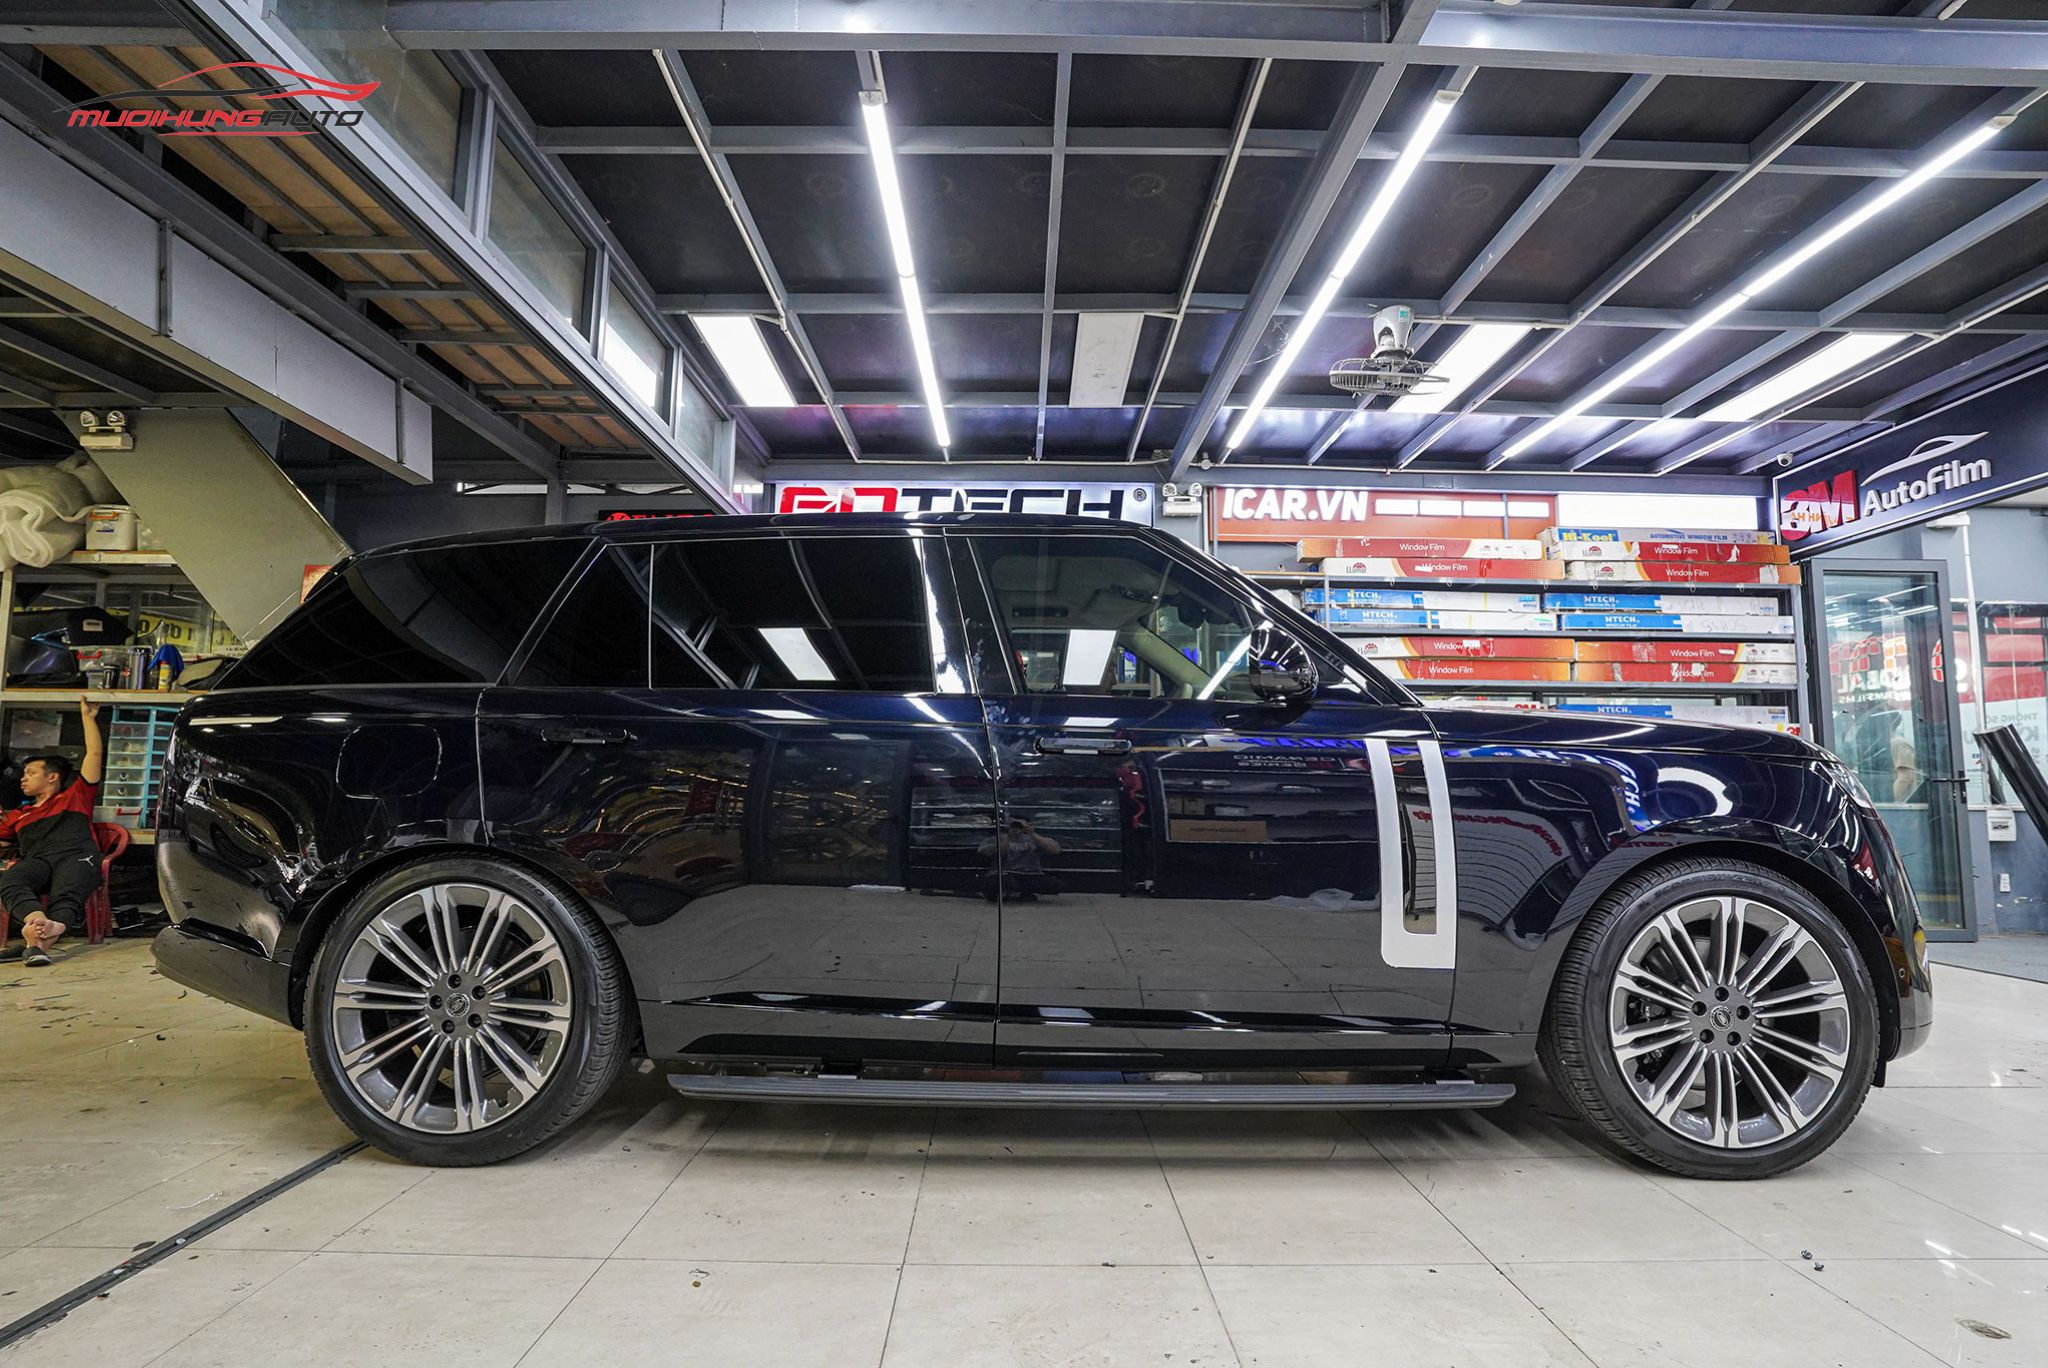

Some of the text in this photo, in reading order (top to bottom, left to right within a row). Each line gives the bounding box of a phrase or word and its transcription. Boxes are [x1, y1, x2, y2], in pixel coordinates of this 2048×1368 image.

[1781, 459, 1992, 541] 3M AutoFilm
[1222, 488, 1368, 521] ICAR.VN
[1400, 543, 1428, 551] Window
[1684, 547, 1698, 555] Film
[1453, 564, 1468, 572] Film
[1666, 569, 1693, 577] Window
[1433, 642, 1462, 650] Window
[1671, 649, 1714, 657] Window Film
[1429, 666, 1473, 674] Window Film
